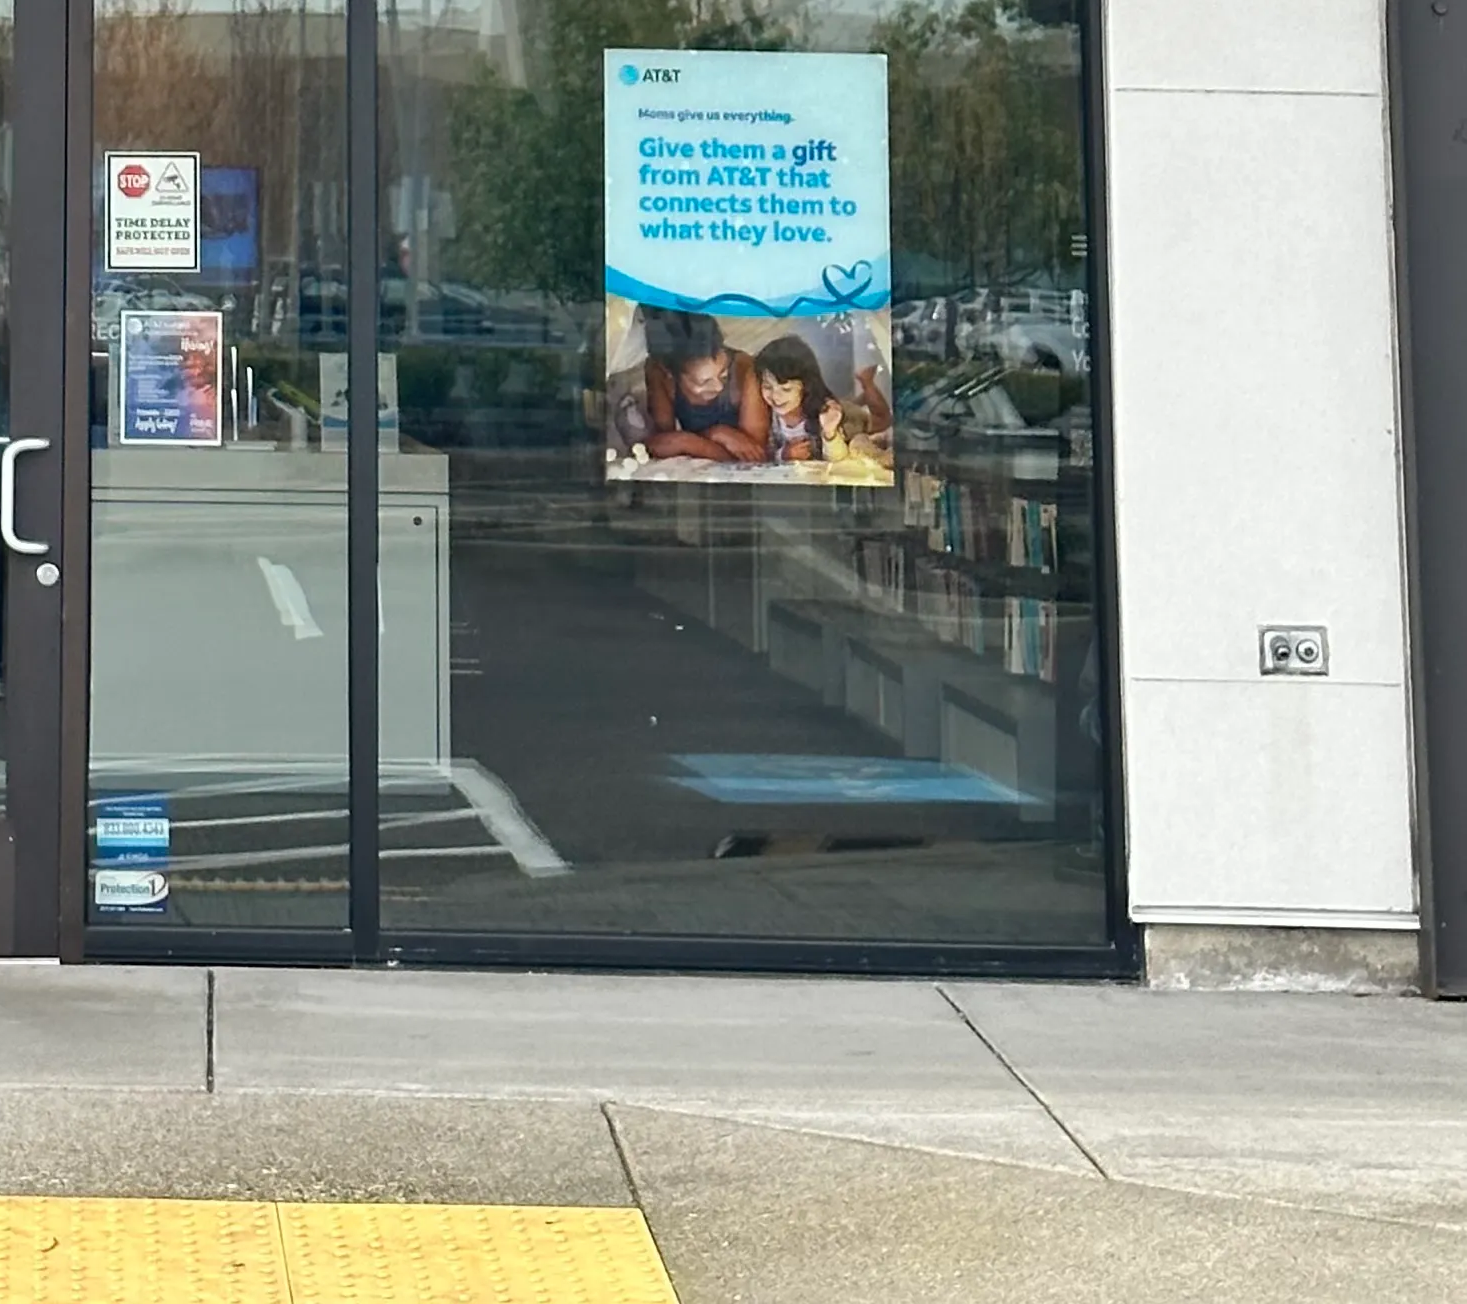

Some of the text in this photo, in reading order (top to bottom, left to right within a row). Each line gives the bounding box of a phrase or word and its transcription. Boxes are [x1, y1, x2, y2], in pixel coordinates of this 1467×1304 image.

[642, 68, 681, 82] AT&T
[677, 109, 704, 123] give
[706, 111, 720, 121] us
[638, 137, 838, 167] Give them a gift
[119, 174, 150, 189] STOP
[638, 163, 831, 189] from AT&T that
[638, 193, 857, 217] connects them to
[115, 217, 191, 228] TIME DELAY
[115, 230, 191, 241] PROTECTED
[639, 218, 833, 247] what they love.
